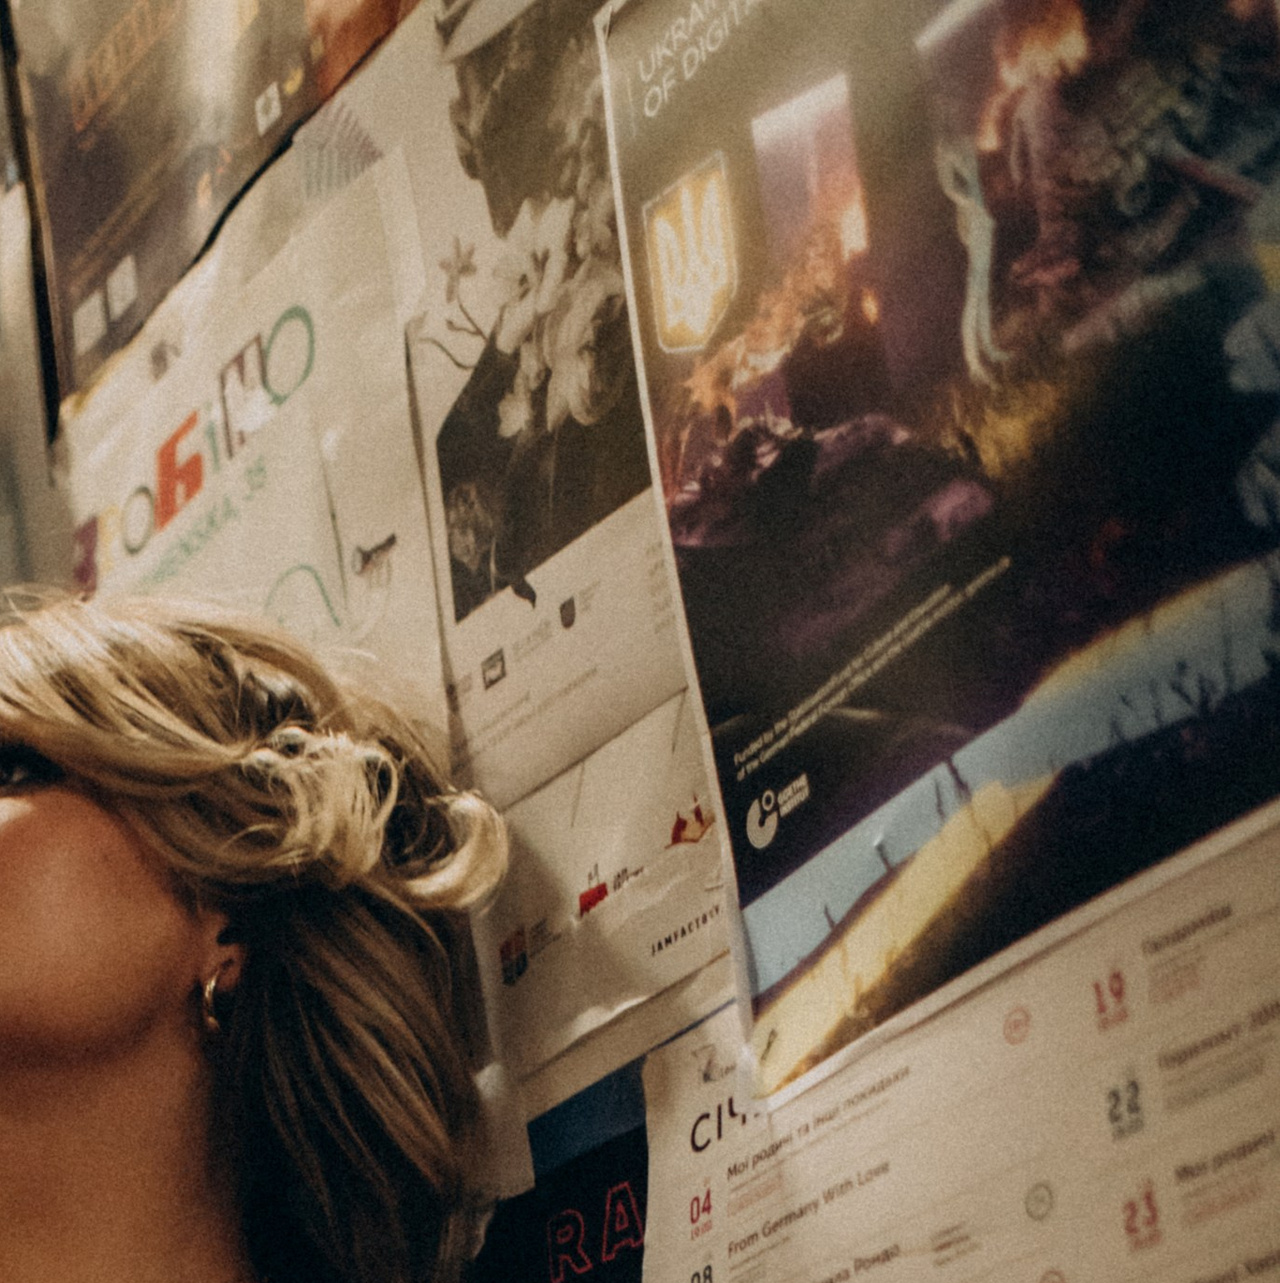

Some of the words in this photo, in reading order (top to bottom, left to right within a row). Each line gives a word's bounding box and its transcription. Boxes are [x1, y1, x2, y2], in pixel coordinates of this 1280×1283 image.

[643, 65, 676, 118] OF
[690, 1188, 713, 1225] 04
[727, 1230, 760, 1259] From
[761, 1198, 820, 1238] Germany
[822, 1180, 854, 1204] With
